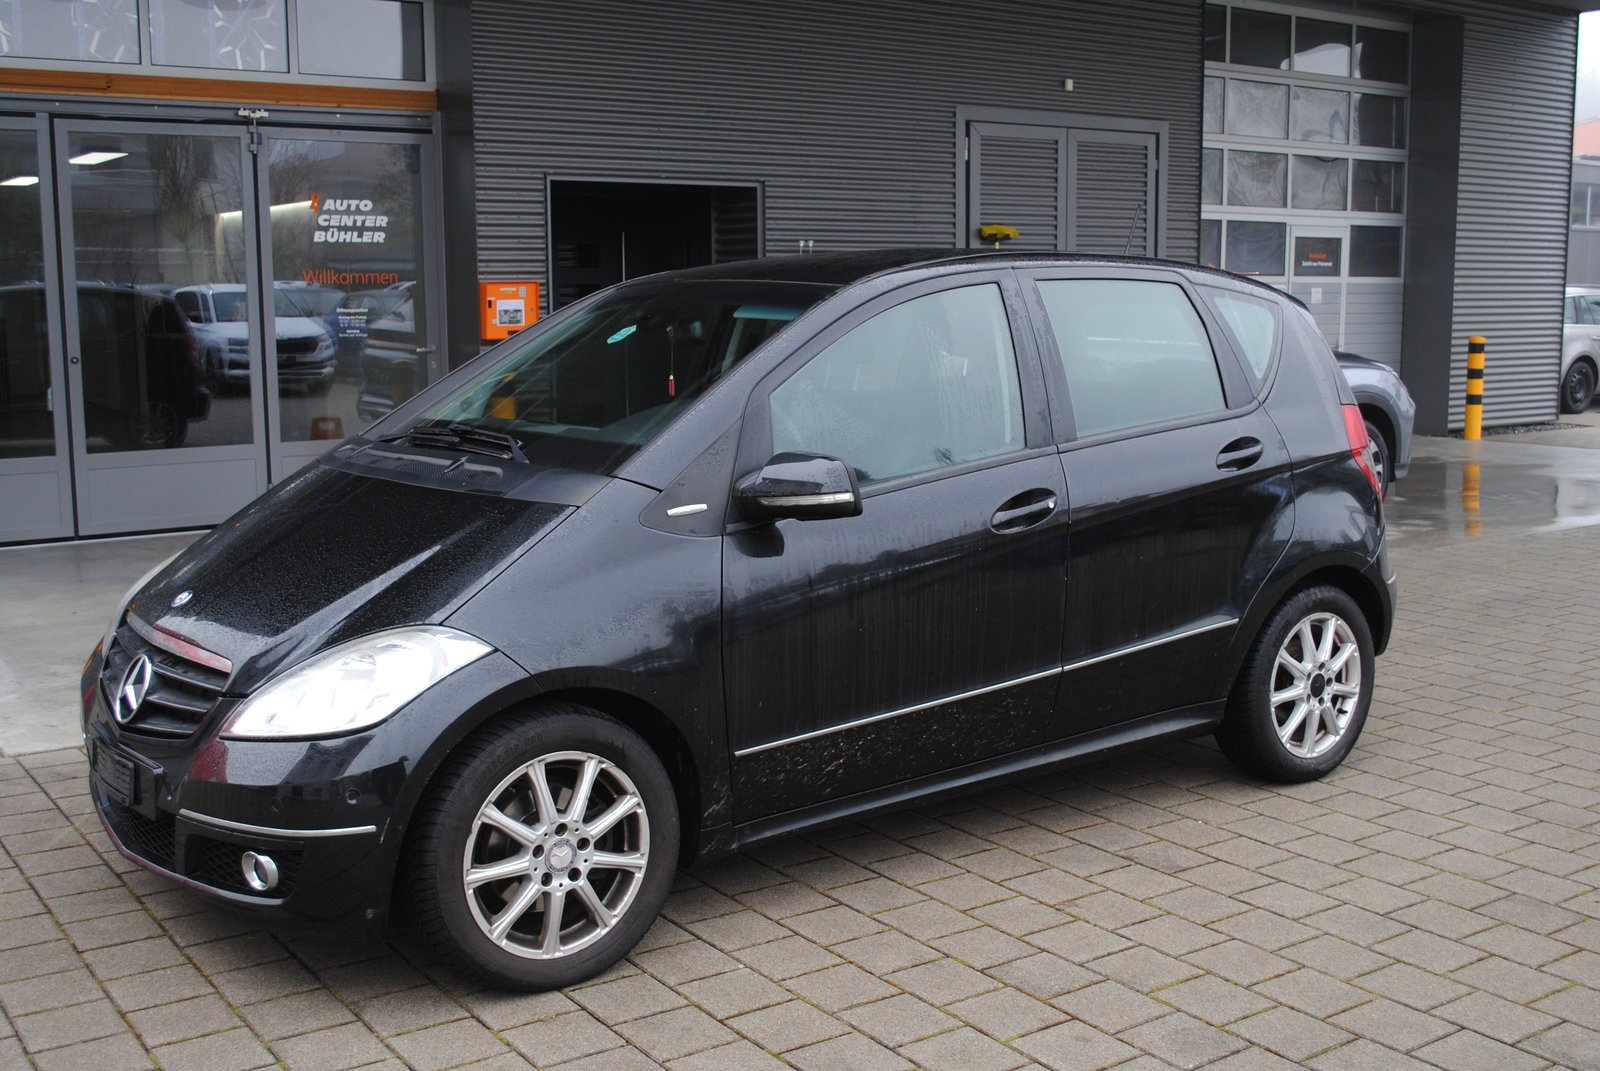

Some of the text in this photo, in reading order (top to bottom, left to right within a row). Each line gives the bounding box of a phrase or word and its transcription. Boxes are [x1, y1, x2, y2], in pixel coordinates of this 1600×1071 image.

[322, 199, 373, 211] AUTO
[317, 214, 389, 227] CENTER
[313, 228, 386, 243] BÜHLER
[303, 269, 399, 285] Willkommen
